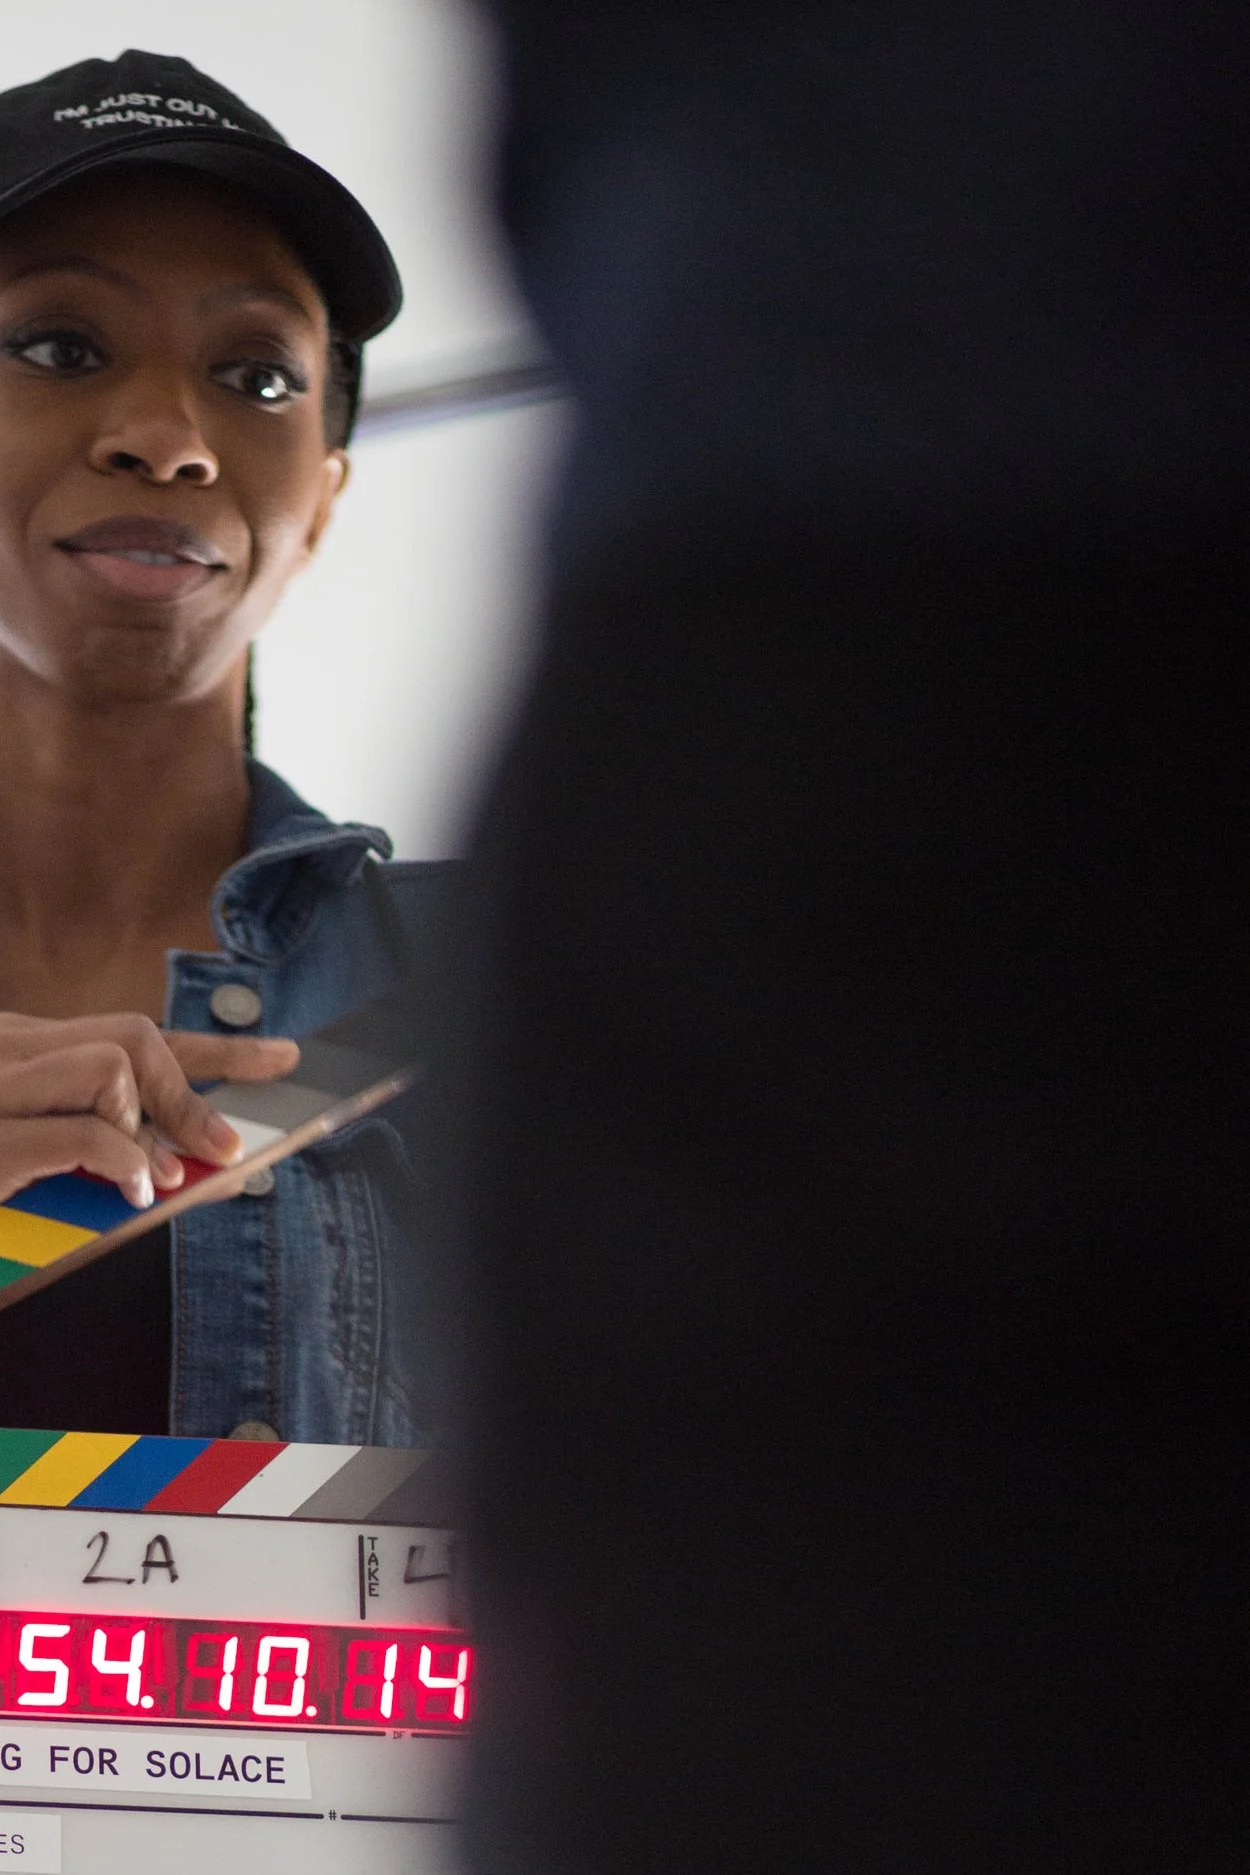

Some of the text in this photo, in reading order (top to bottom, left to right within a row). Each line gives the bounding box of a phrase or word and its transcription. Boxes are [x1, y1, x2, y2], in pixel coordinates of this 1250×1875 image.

[94, 93, 162, 113] JUST
[165, 98, 218, 120] OUT
[82, 1531, 179, 1584] 2A
[367, 1536, 380, 1597] TAKE
[49, 1745, 119, 1776] FOR
[146, 1749, 286, 1784] SOLACE
